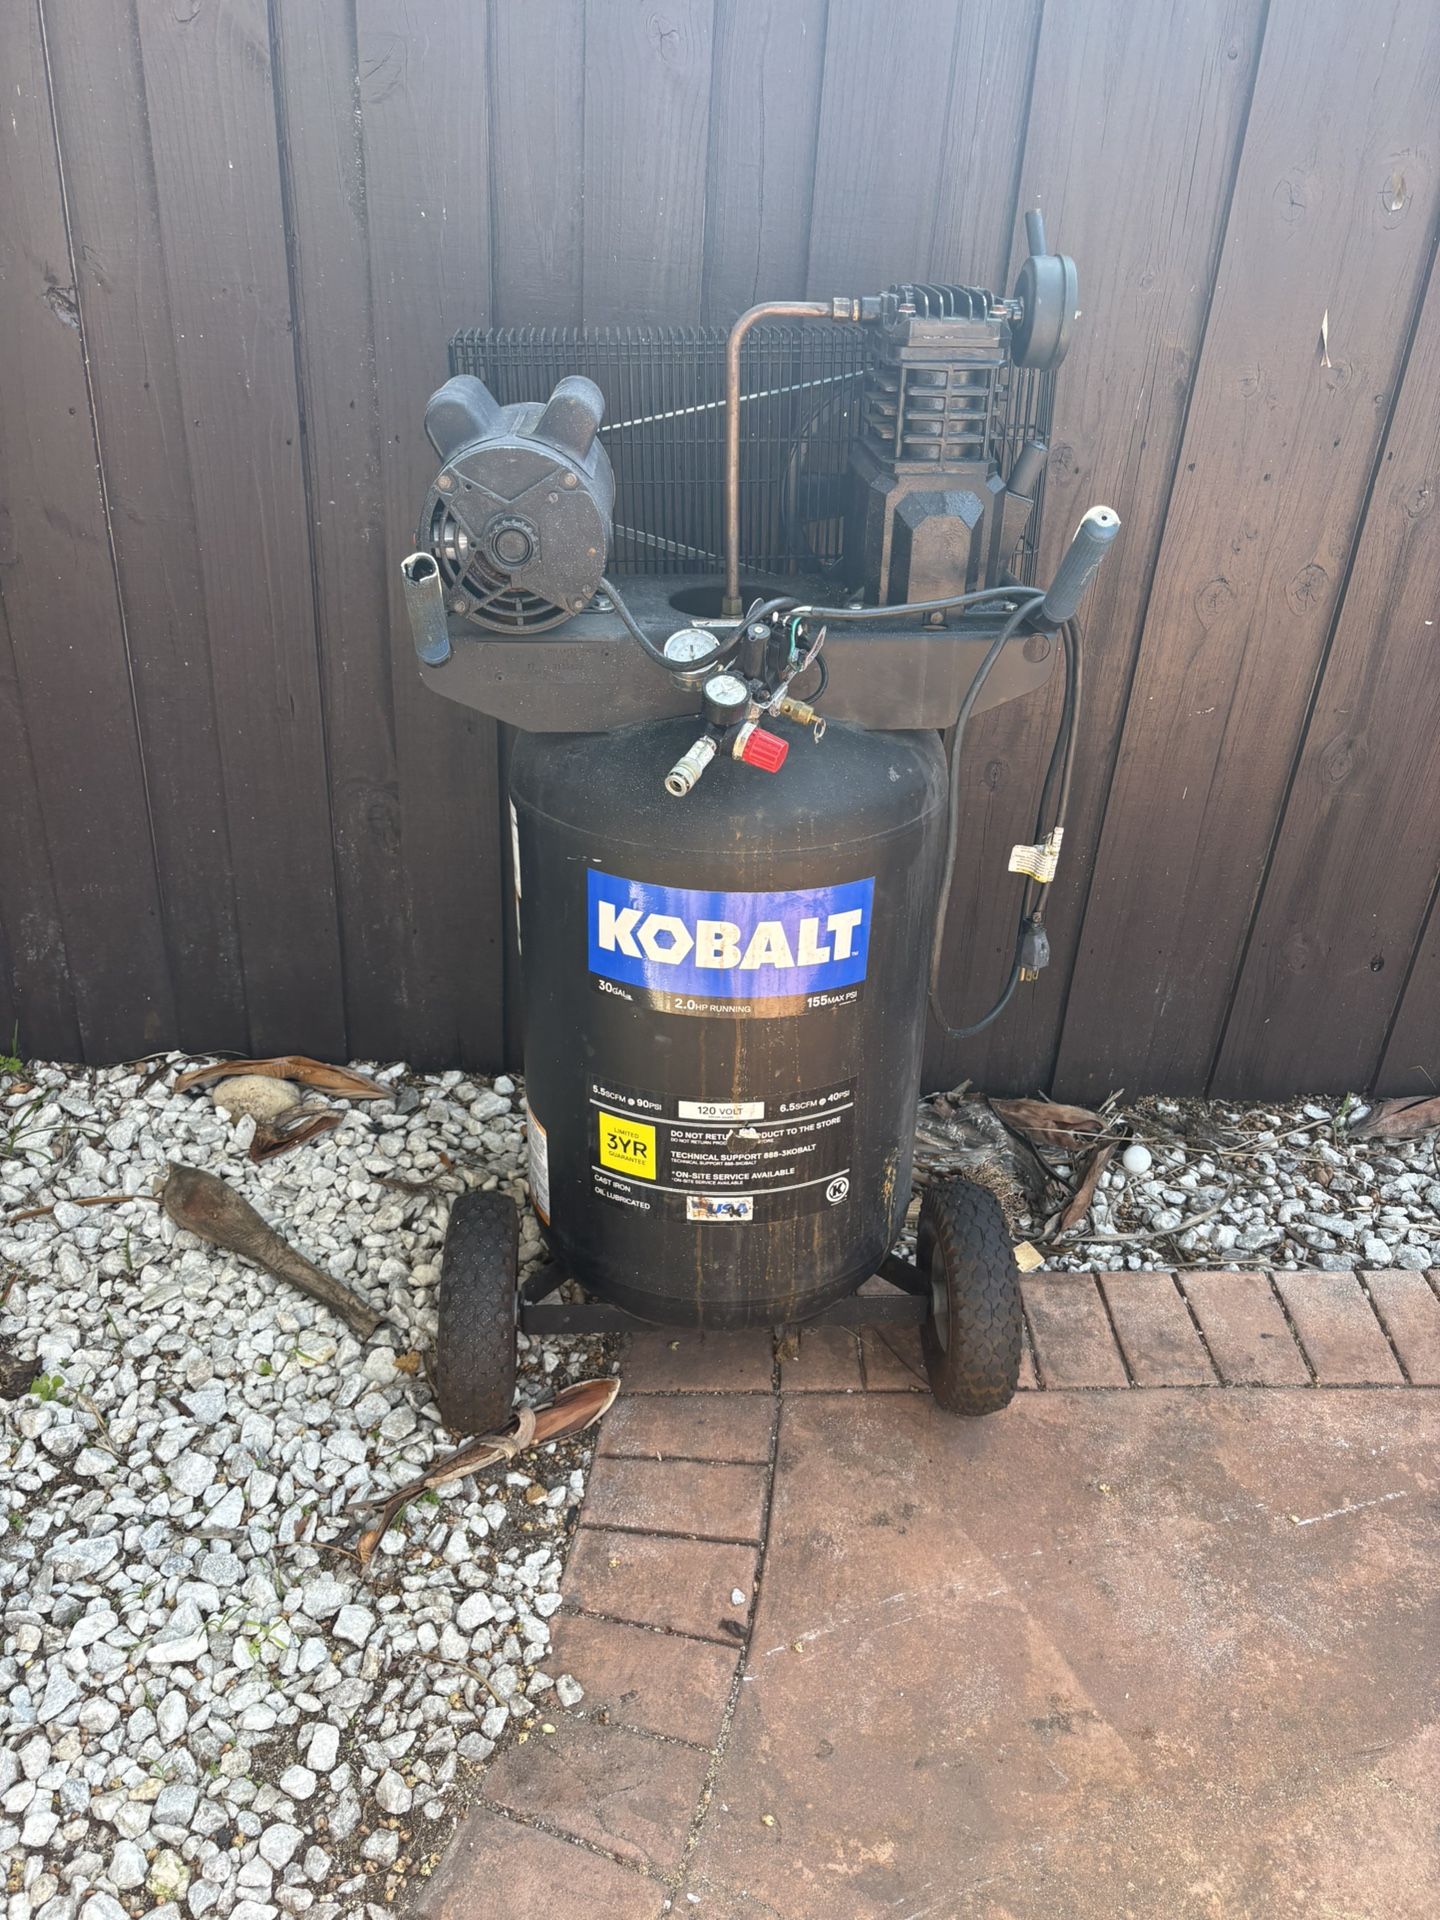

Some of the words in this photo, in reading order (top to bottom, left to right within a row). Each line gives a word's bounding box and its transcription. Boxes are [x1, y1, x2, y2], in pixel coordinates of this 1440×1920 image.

[598, 899, 862, 970] KOBALT
[674, 998, 708, 1011] 2.0HP
[709, 1004, 752, 1013] RUNNING
[807, 994, 844, 1008] 155MAX
[845, 990, 858, 1001] PSI
[592, 1084, 626, 1103] 5.5SCFM
[636, 1098, 662, 1111] 90PSI
[779, 1100, 818, 1113] 6.5SCFM
[827, 1089, 851, 1102] 40PSI
[697, 1106, 716, 1115] 120
[719, 1107, 743, 1116] VOLT
[614, 1127, 640, 1140] LIMITED
[670, 1130, 683, 1138] DO
[684, 1131, 704, 1140] NOT
[786, 1127, 797, 1136] TO
[799, 1123, 816, 1133] THE
[816, 1116, 842, 1130] STORE
[607, 1132, 648, 1158] 3YR
[670, 1150, 719, 1161] TECHNICAL
[720, 1152, 762, 1161] SUPPORT
[763, 1143, 816, 1159] 888-3KOBALT
[608, 1150, 647, 1166] GUARANTEE
[594, 1173, 612, 1187] CAST
[612, 1179, 631, 1193] IRON
[712, 1173, 750, 1181] SERVICE
[751, 1167, 795, 1180] AVAILABLE
[594, 1186, 606, 1197] OIL
[606, 1189, 651, 1210] LUBRICATED
